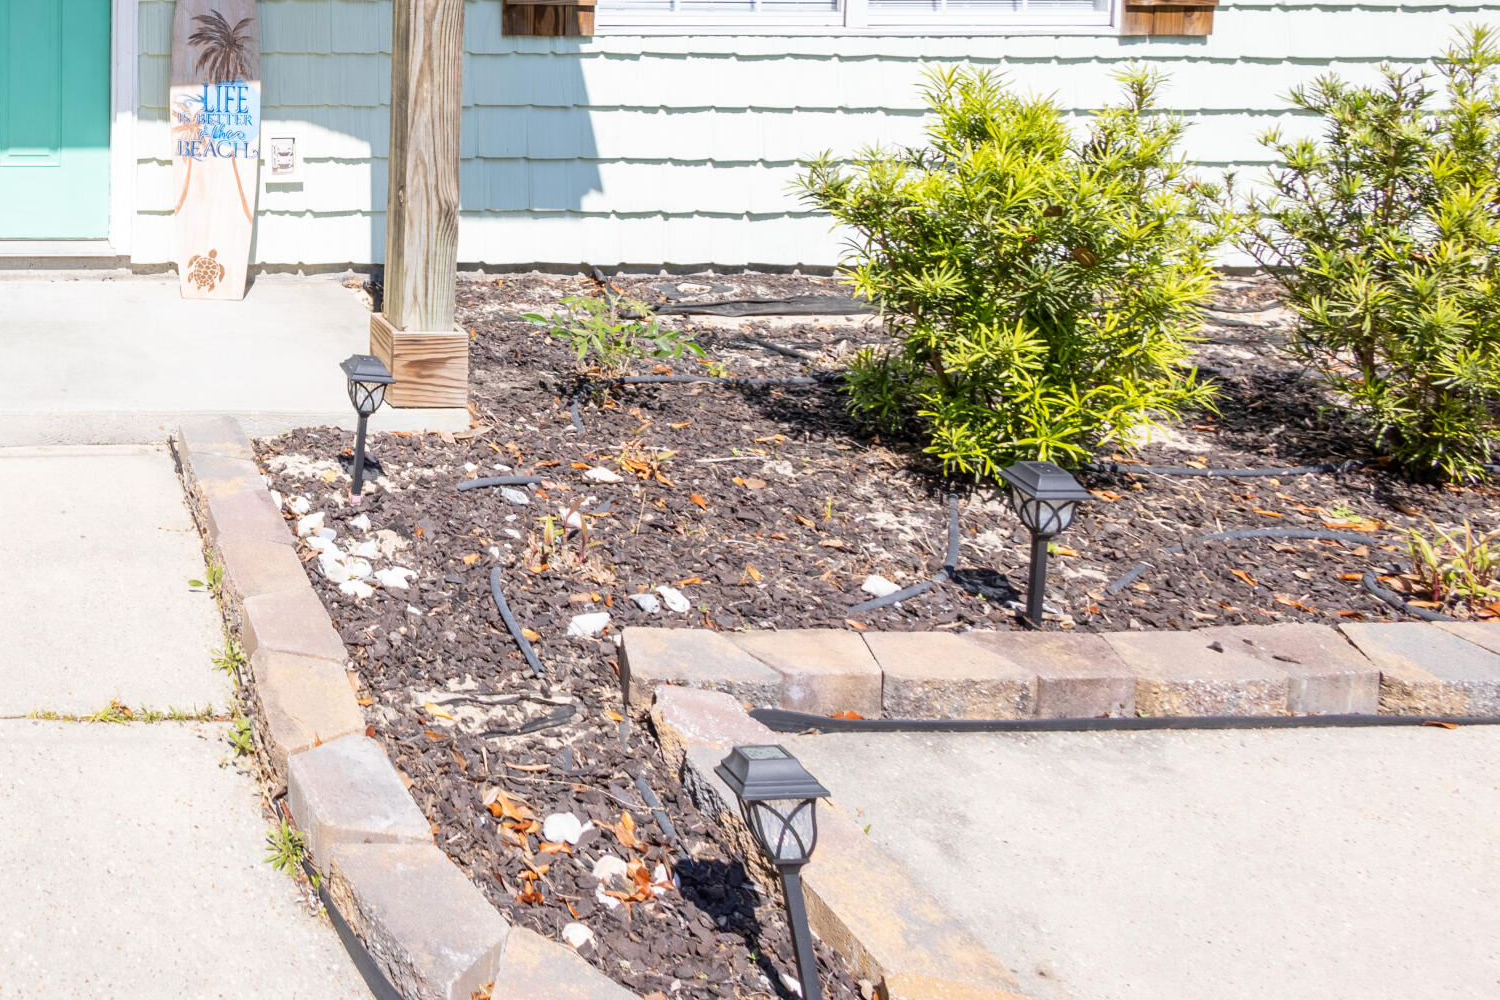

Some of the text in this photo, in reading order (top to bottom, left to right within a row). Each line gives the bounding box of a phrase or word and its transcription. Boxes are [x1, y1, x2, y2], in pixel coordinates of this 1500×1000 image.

[202, 83, 248, 113] LIFE
[178, 112, 252, 126] IS BETTER
[177, 140, 249, 158] BEACH
